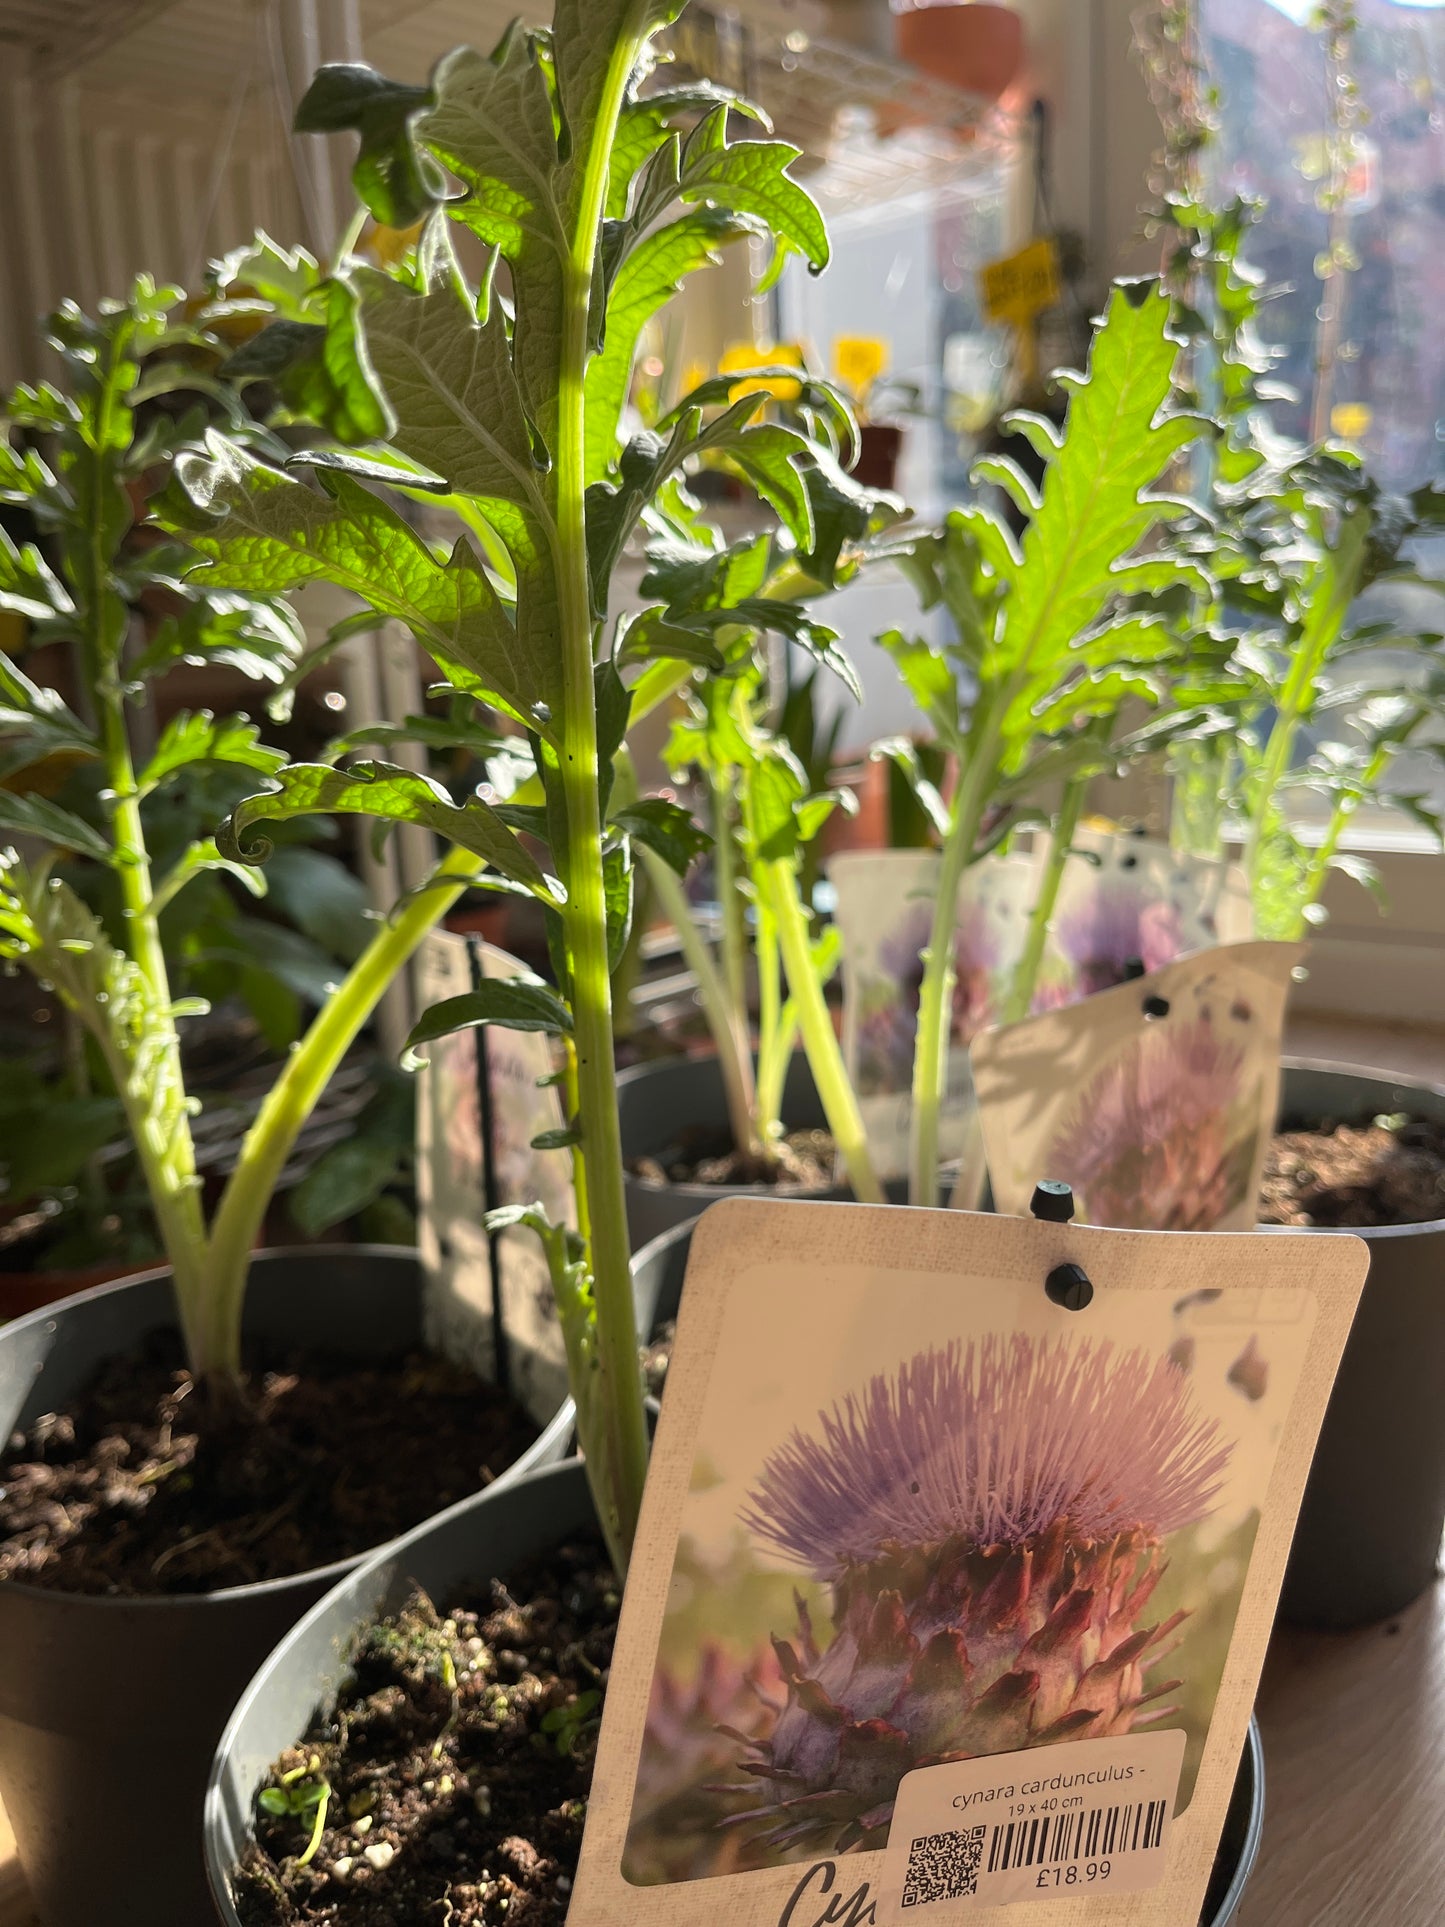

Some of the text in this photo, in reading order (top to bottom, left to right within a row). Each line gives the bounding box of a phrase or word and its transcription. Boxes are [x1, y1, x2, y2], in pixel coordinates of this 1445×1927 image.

[952, 1785, 1015, 1811] cynara
[1021, 1765, 1134, 1794] cardunculus
[1008, 1795, 1083, 1817] 19 x 40 cm
[1036, 1860, 1111, 1888] £18.99
